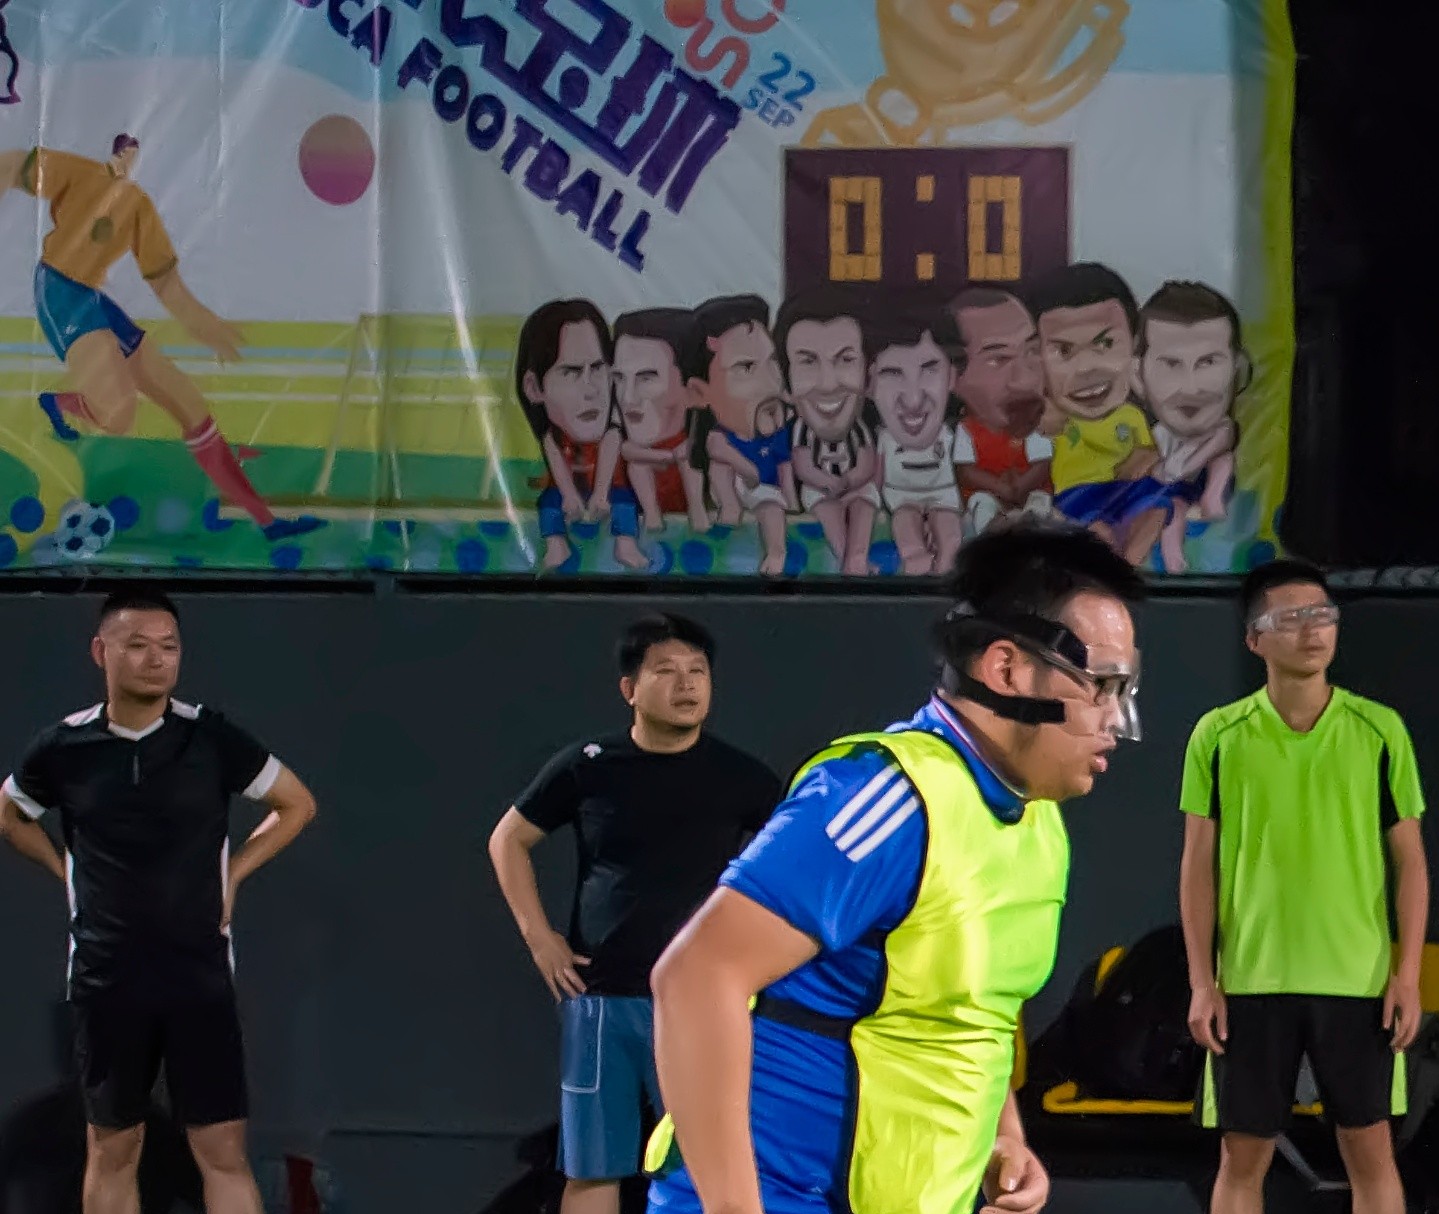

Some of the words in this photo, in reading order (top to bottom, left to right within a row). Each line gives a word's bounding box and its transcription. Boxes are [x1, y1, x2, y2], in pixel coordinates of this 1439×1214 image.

[744, 87, 796, 128] SEP
[758, 52, 816, 111] 22
[397, 36, 652, 274] FOOTBALL
